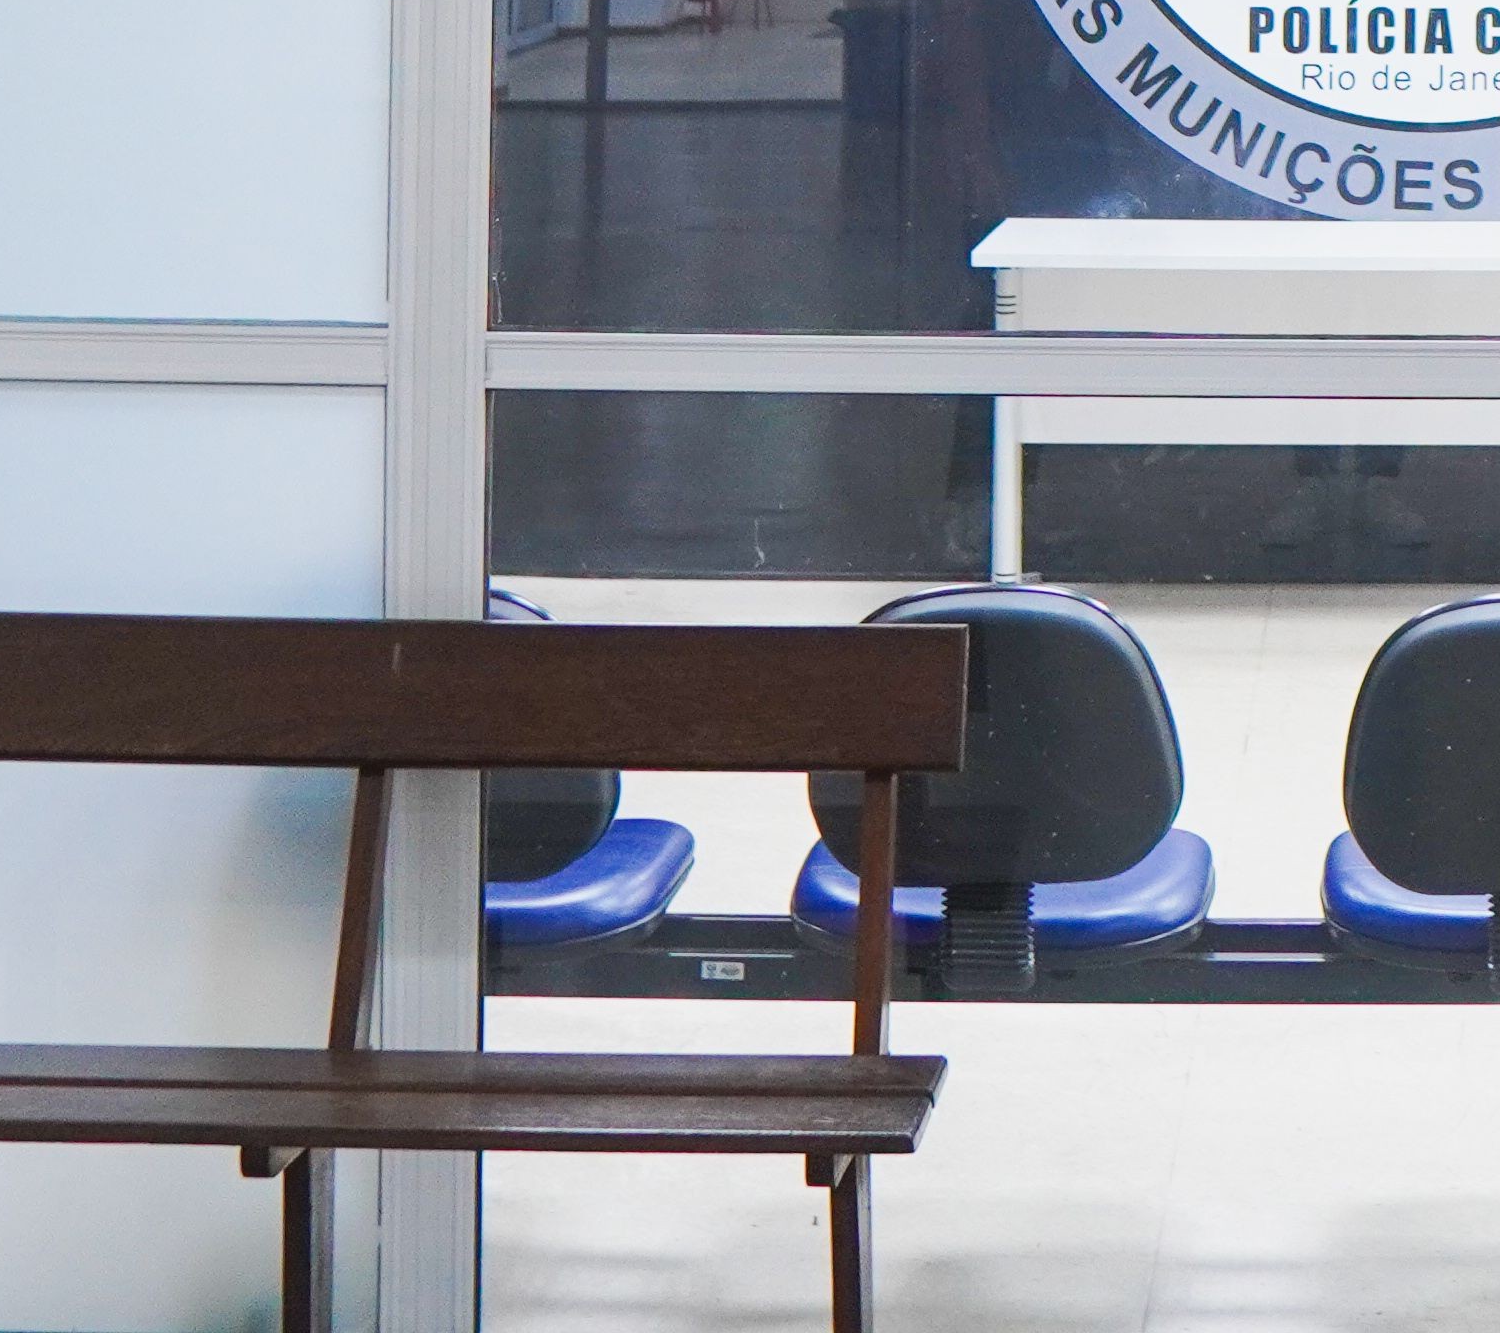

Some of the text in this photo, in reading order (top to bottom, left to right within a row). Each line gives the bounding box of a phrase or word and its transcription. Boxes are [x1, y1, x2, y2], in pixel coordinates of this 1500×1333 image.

[1114, 41, 1485, 212] MUNIÇÕES
[1301, 62, 1357, 92] Rio
[1371, 64, 1412, 92] de
